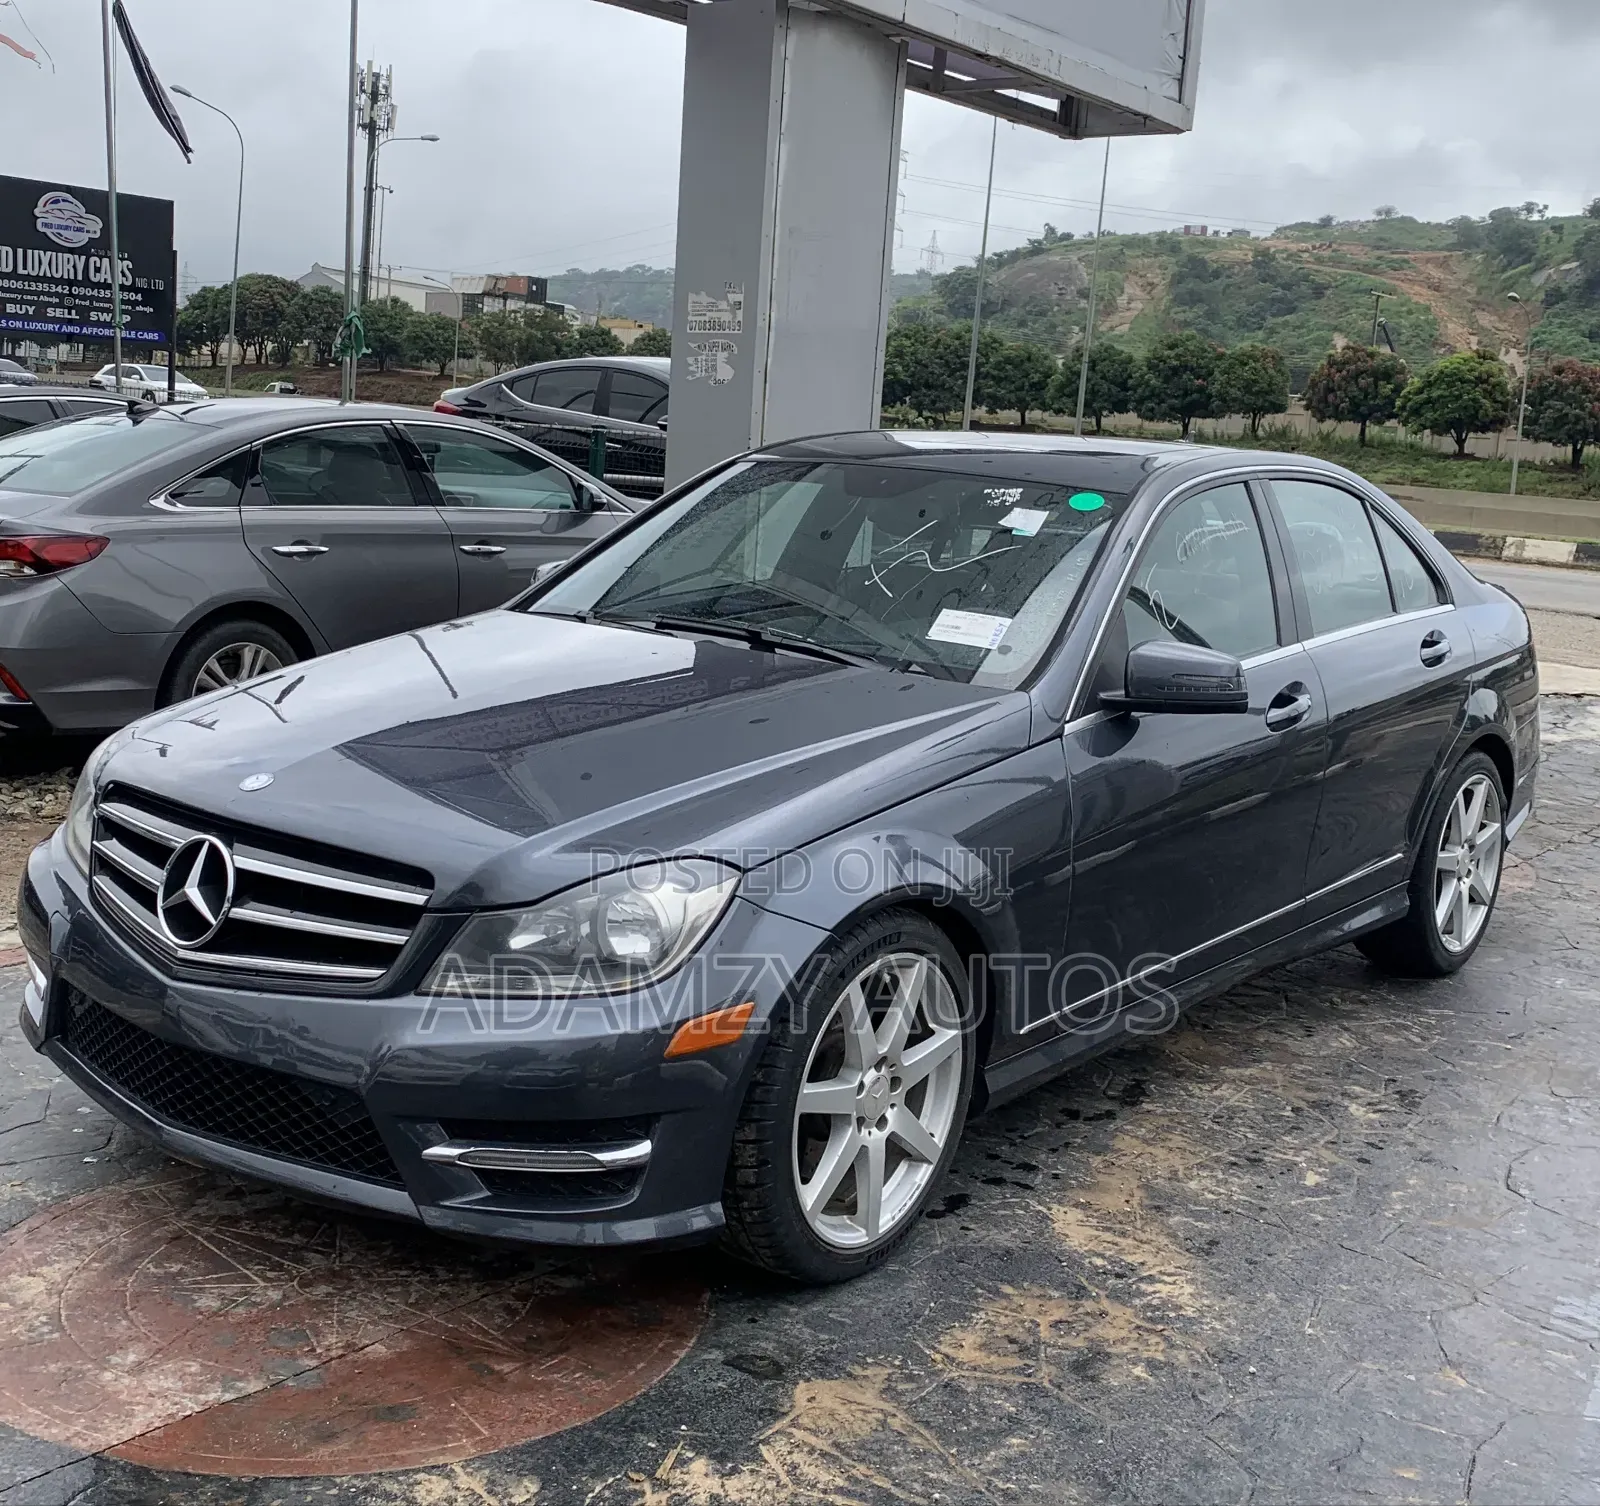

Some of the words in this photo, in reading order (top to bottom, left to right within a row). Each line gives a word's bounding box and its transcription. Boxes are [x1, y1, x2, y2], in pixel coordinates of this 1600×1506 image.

[17, 248, 86, 280] LUXURY
[151, 279, 164, 290] LTD
[6, 303, 36, 315] BUY
[47, 307, 79, 319] SELL
[90, 311, 131, 325] SWP
[8, 320, 22, 328] ON
[24, 322, 60, 332] LUXURY
[61, 325, 80, 334] AND
[82, 327, 136, 338] AFFORDBLE
[137, 332, 159, 340] CARS
